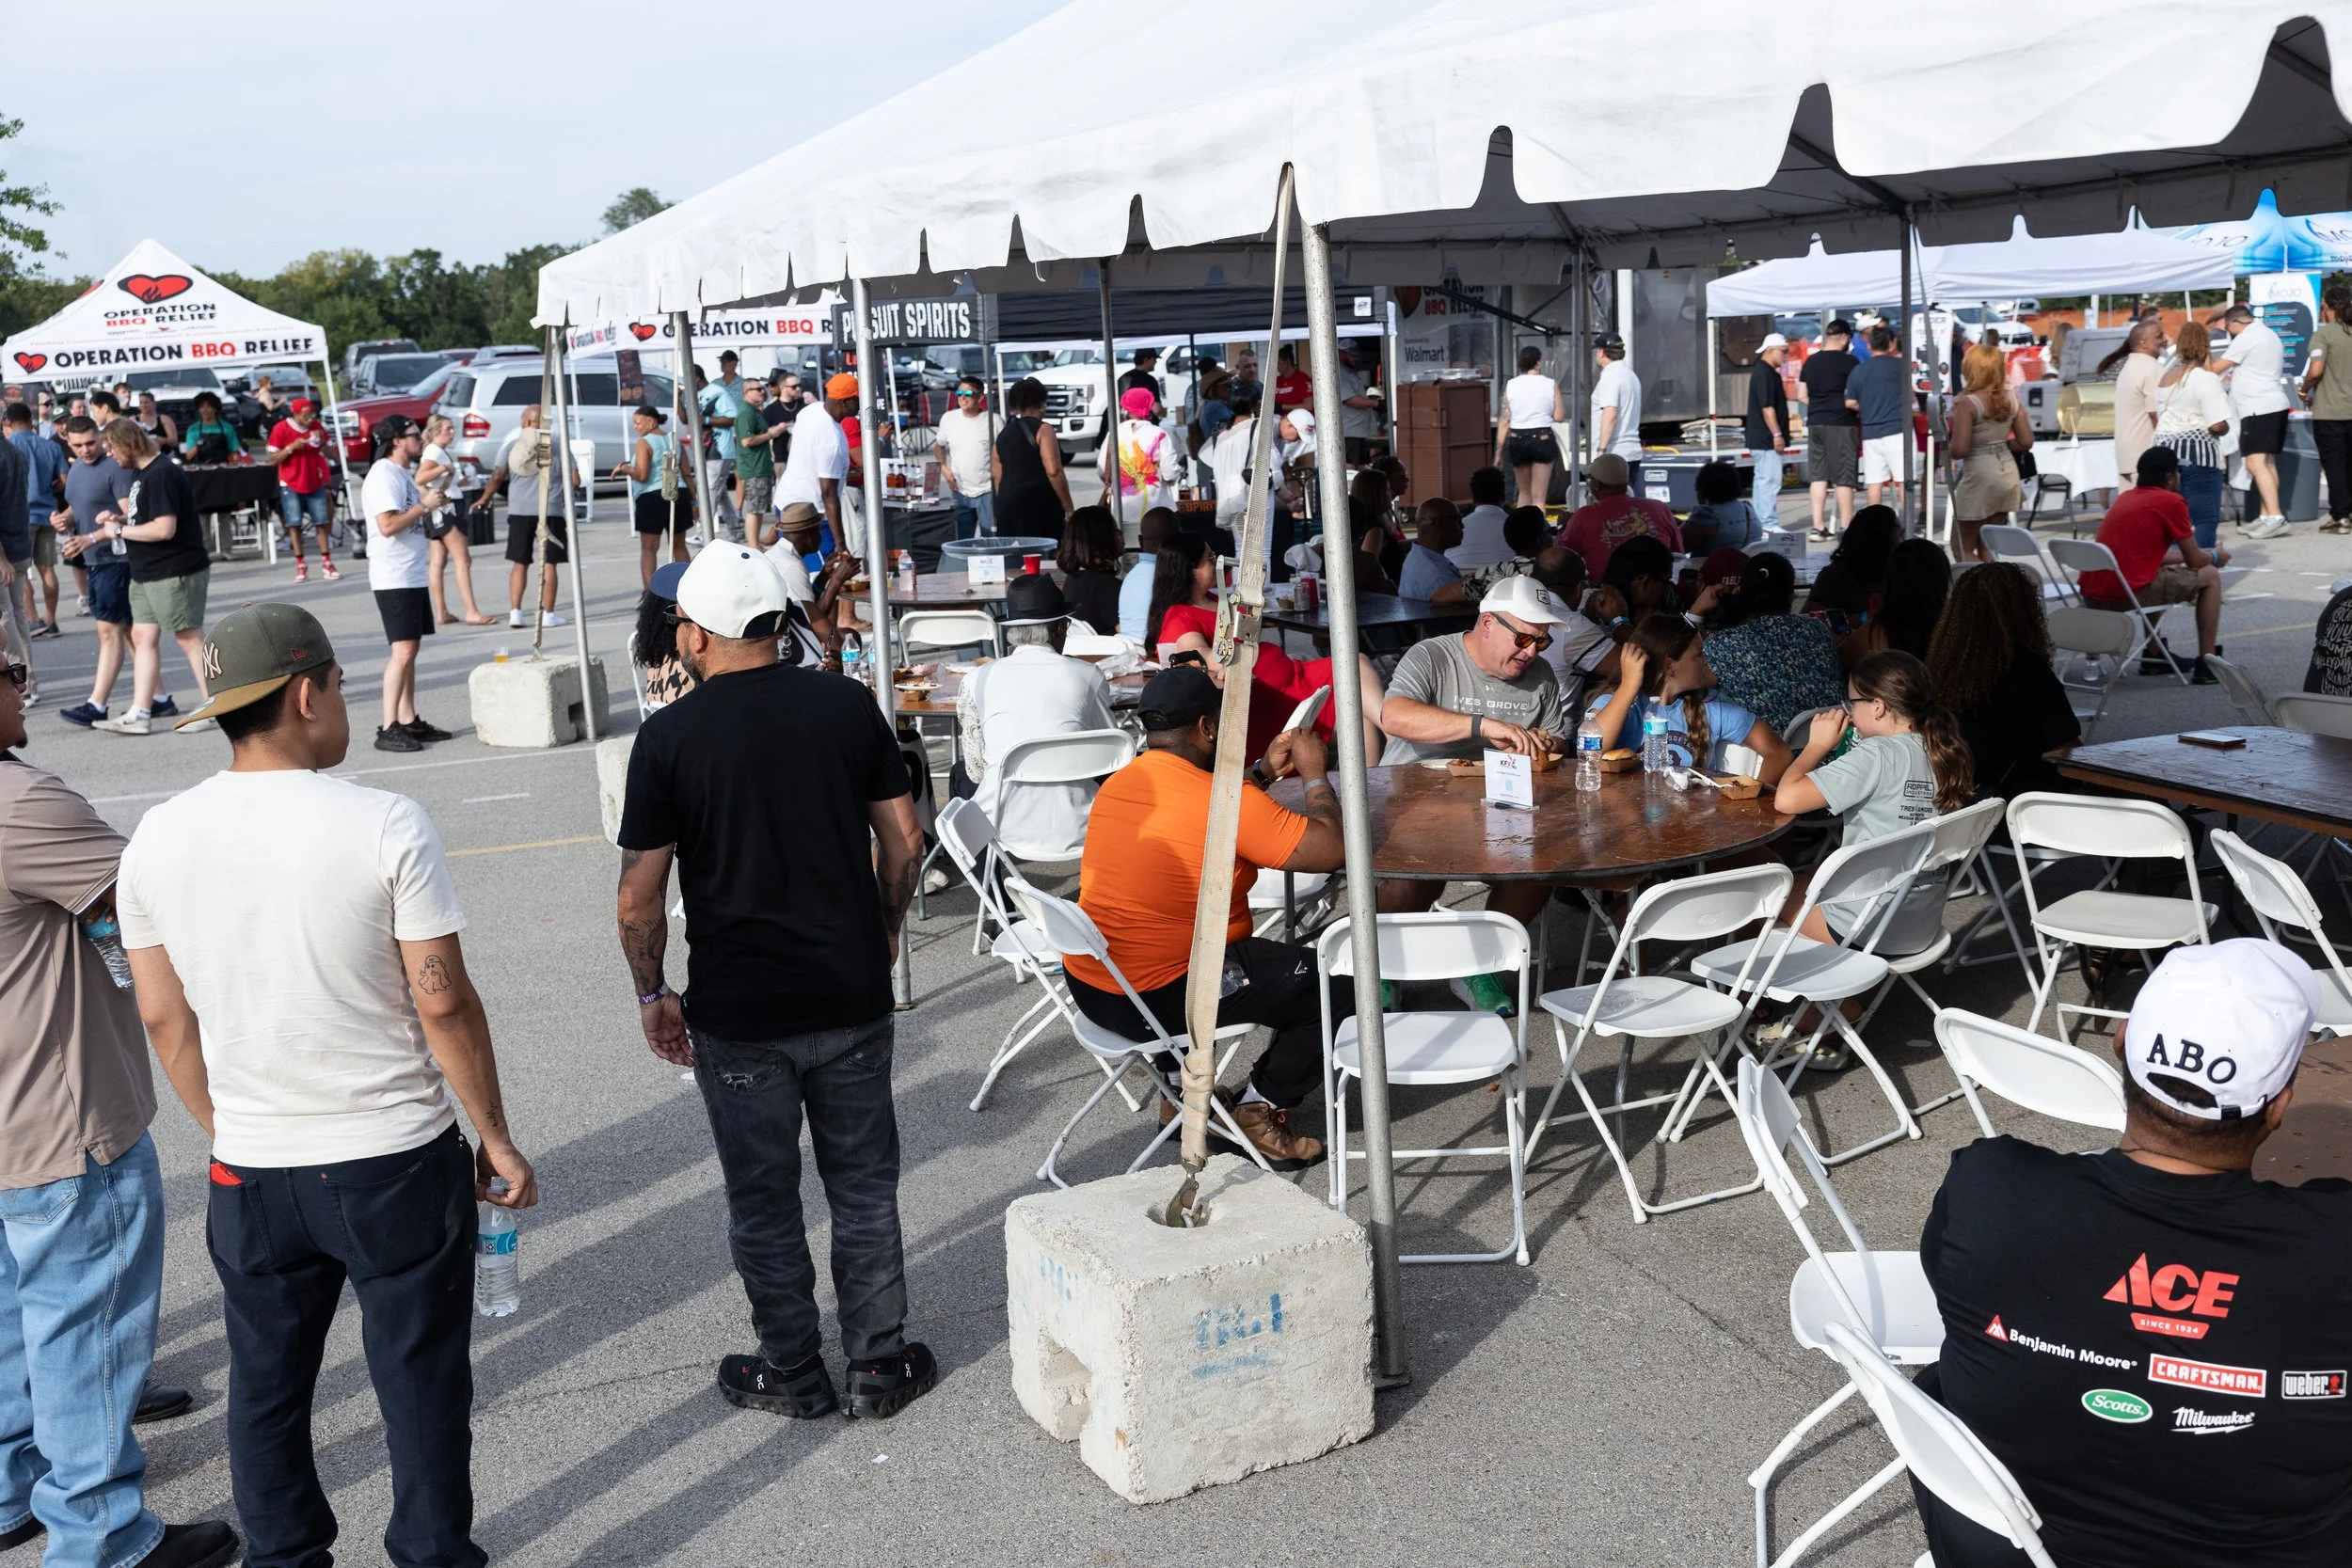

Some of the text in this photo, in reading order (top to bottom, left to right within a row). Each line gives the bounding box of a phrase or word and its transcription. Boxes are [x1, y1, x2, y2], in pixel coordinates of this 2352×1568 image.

[103, 304, 215, 319] OPERATION
[1425, 299, 1447, 316] BBQ
[105, 313, 216, 327] BBQ RELIEF
[662, 320, 769, 337] OERATION
[776, 319, 814, 334] BBQ
[842, 302, 971, 343] PSUIT SPIRITS
[55, 344, 183, 368] OPERATION
[191, 342, 236, 358] BBQ
[245, 339, 313, 355] RELIEF
[1405, 346, 1444, 362] Walmart
[202, 641, 223, 679] NY
[1454, 695, 1528, 710] IVES GROVE
[1907, 784, 1932, 792] ROPPEL
[643, 993, 657, 1004] VIP
[2146, 1033, 2237, 1085] ABO
[2103, 1252, 2240, 1318] ACE
[2139, 1318, 2200, 1335] SINCE 1924
[2009, 1328, 2075, 1360] Benjamin
[2156, 1361, 2259, 1390] CRAFTSMAN
[2091, 1394, 2141, 1416] Scotts
[2172, 1406, 2253, 1427] Milwaukee
